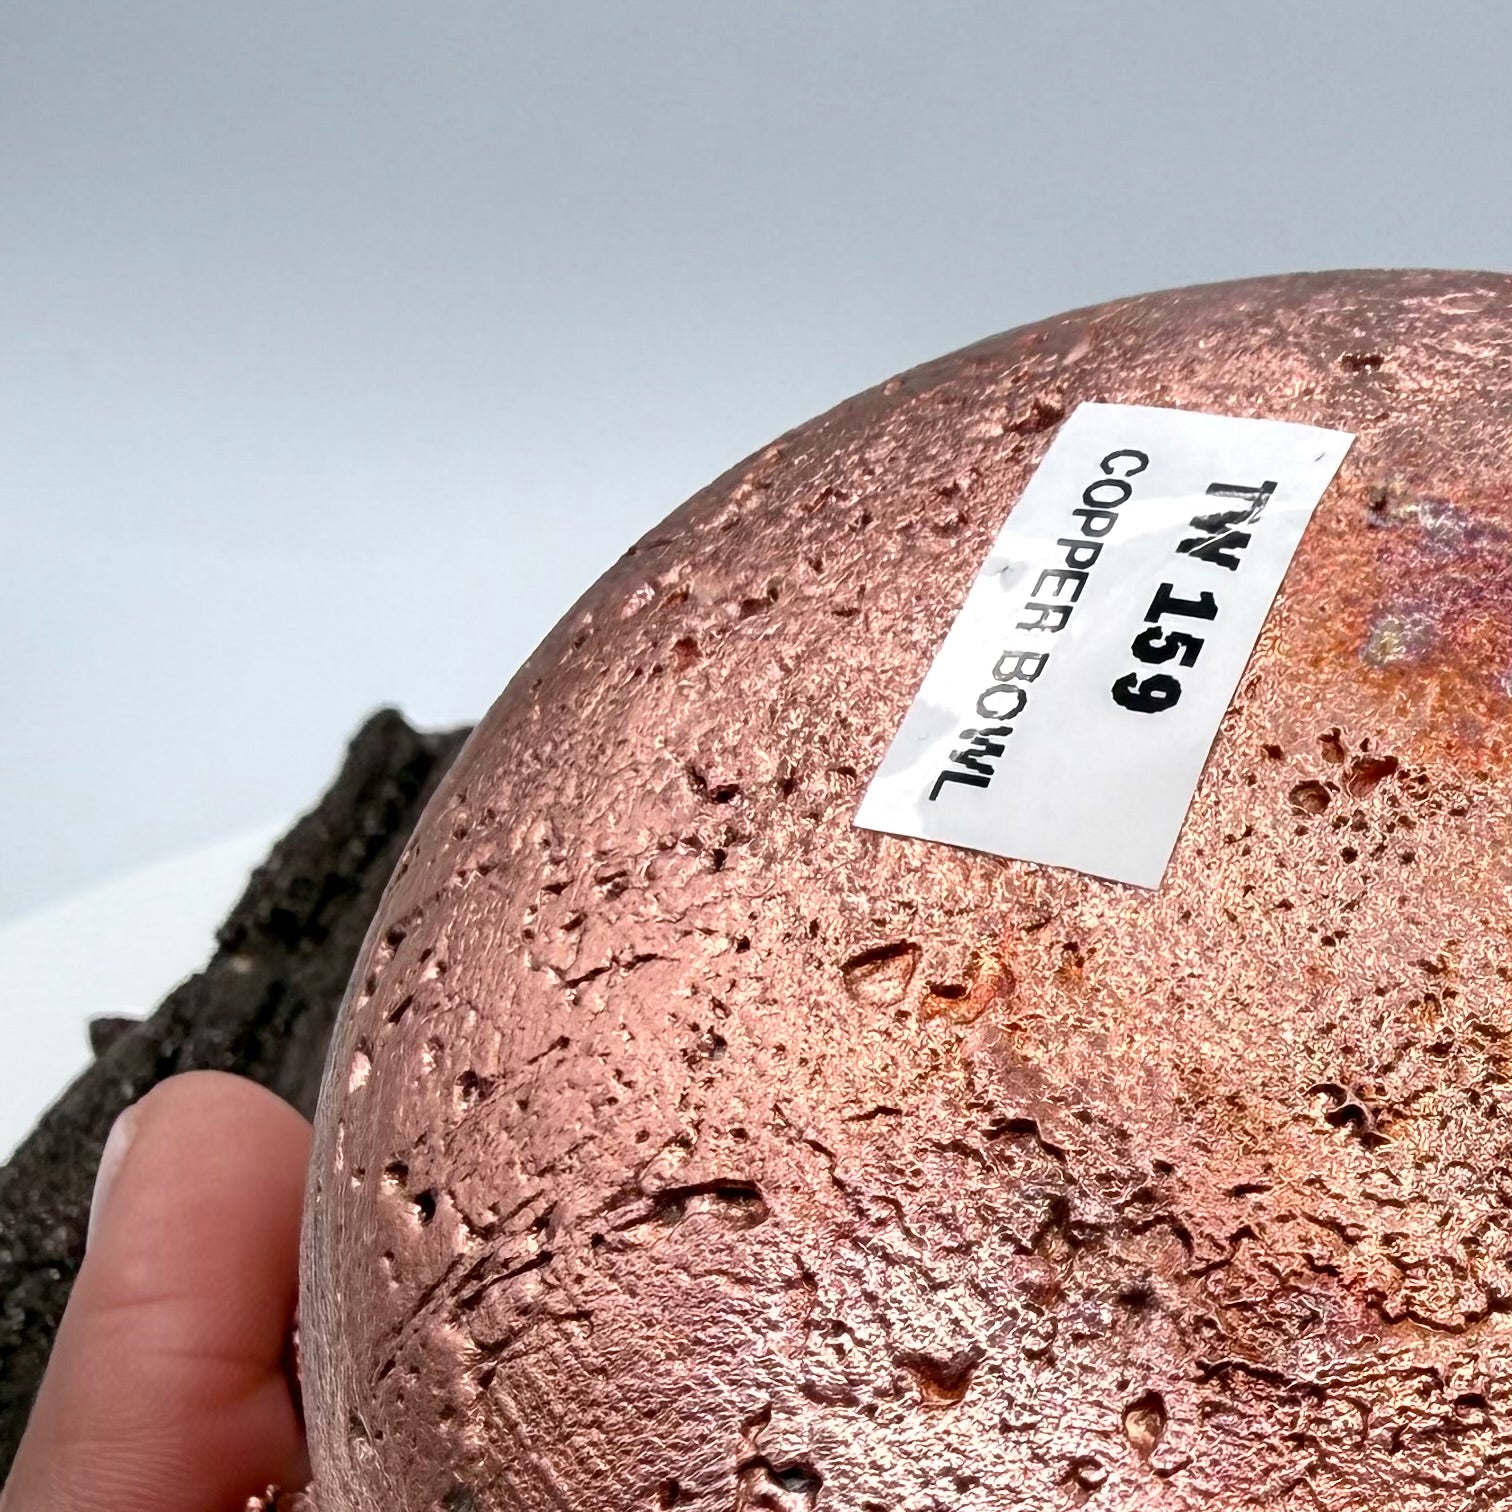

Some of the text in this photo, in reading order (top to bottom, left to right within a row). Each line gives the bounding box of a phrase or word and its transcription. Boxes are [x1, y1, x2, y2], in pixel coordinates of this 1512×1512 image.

[928, 449, 1150, 801] COPPER BOWL
[1111, 480, 1278, 714] TW 159
